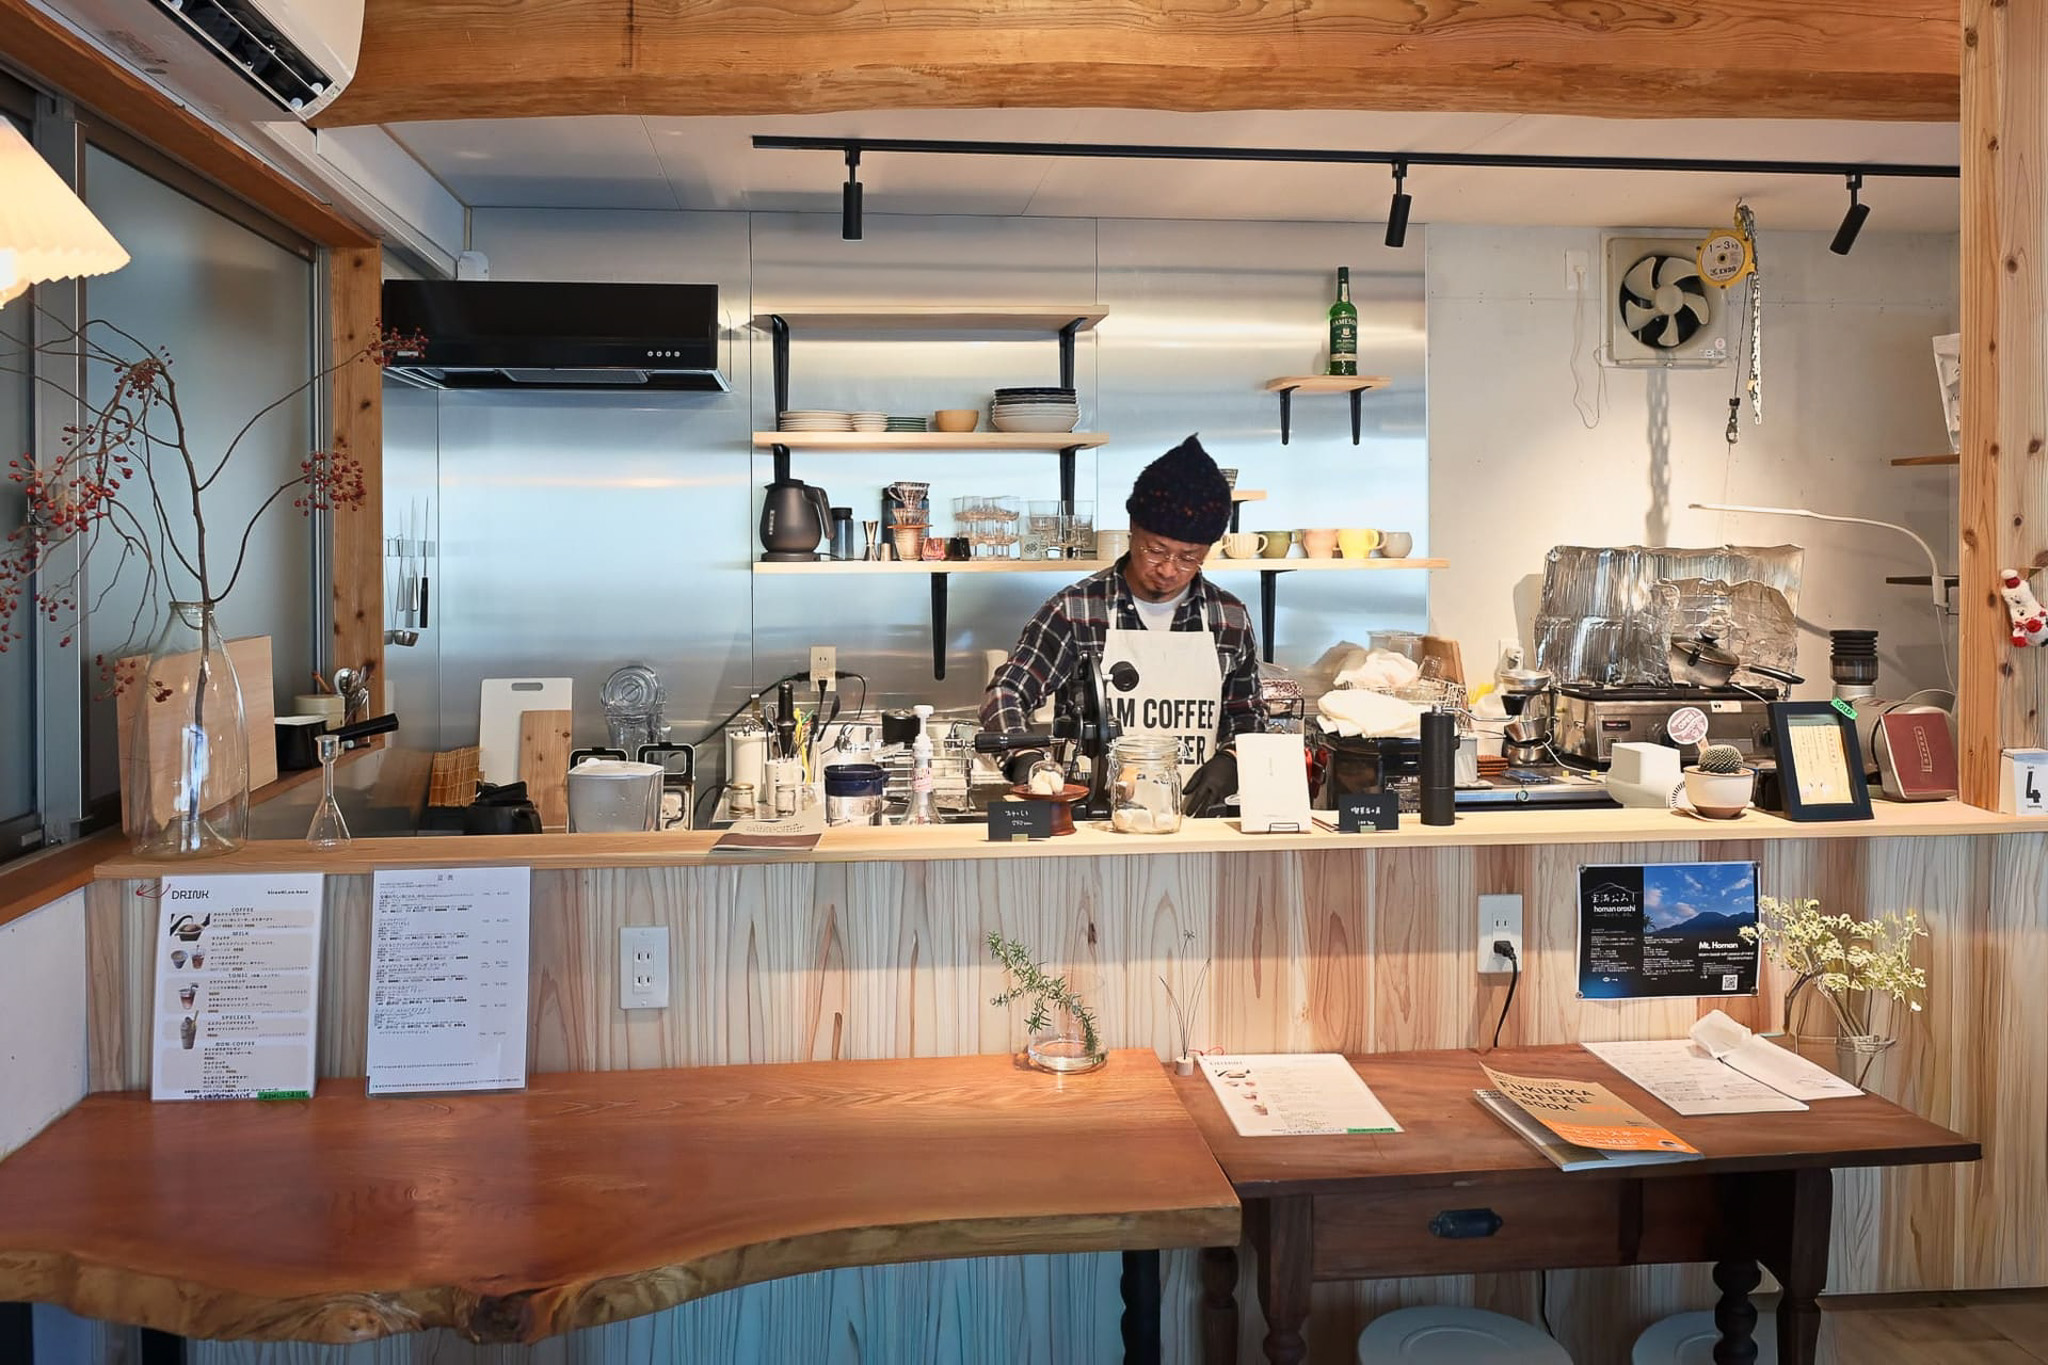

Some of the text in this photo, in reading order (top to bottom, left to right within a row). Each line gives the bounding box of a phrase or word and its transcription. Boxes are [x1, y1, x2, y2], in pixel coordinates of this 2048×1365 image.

[1143, 698, 1215, 729] COFFEE
[2026, 771, 2041, 803] 4
[171, 889, 210, 900] DRINK
[1593, 905, 1616, 913] homan
[1711, 941, 1739, 949] Homan
[1499, 1080, 1596, 1097] FUKUOKA
[1508, 1090, 1593, 1105] COFFEE
[1519, 1099, 1577, 1112] BOOK
